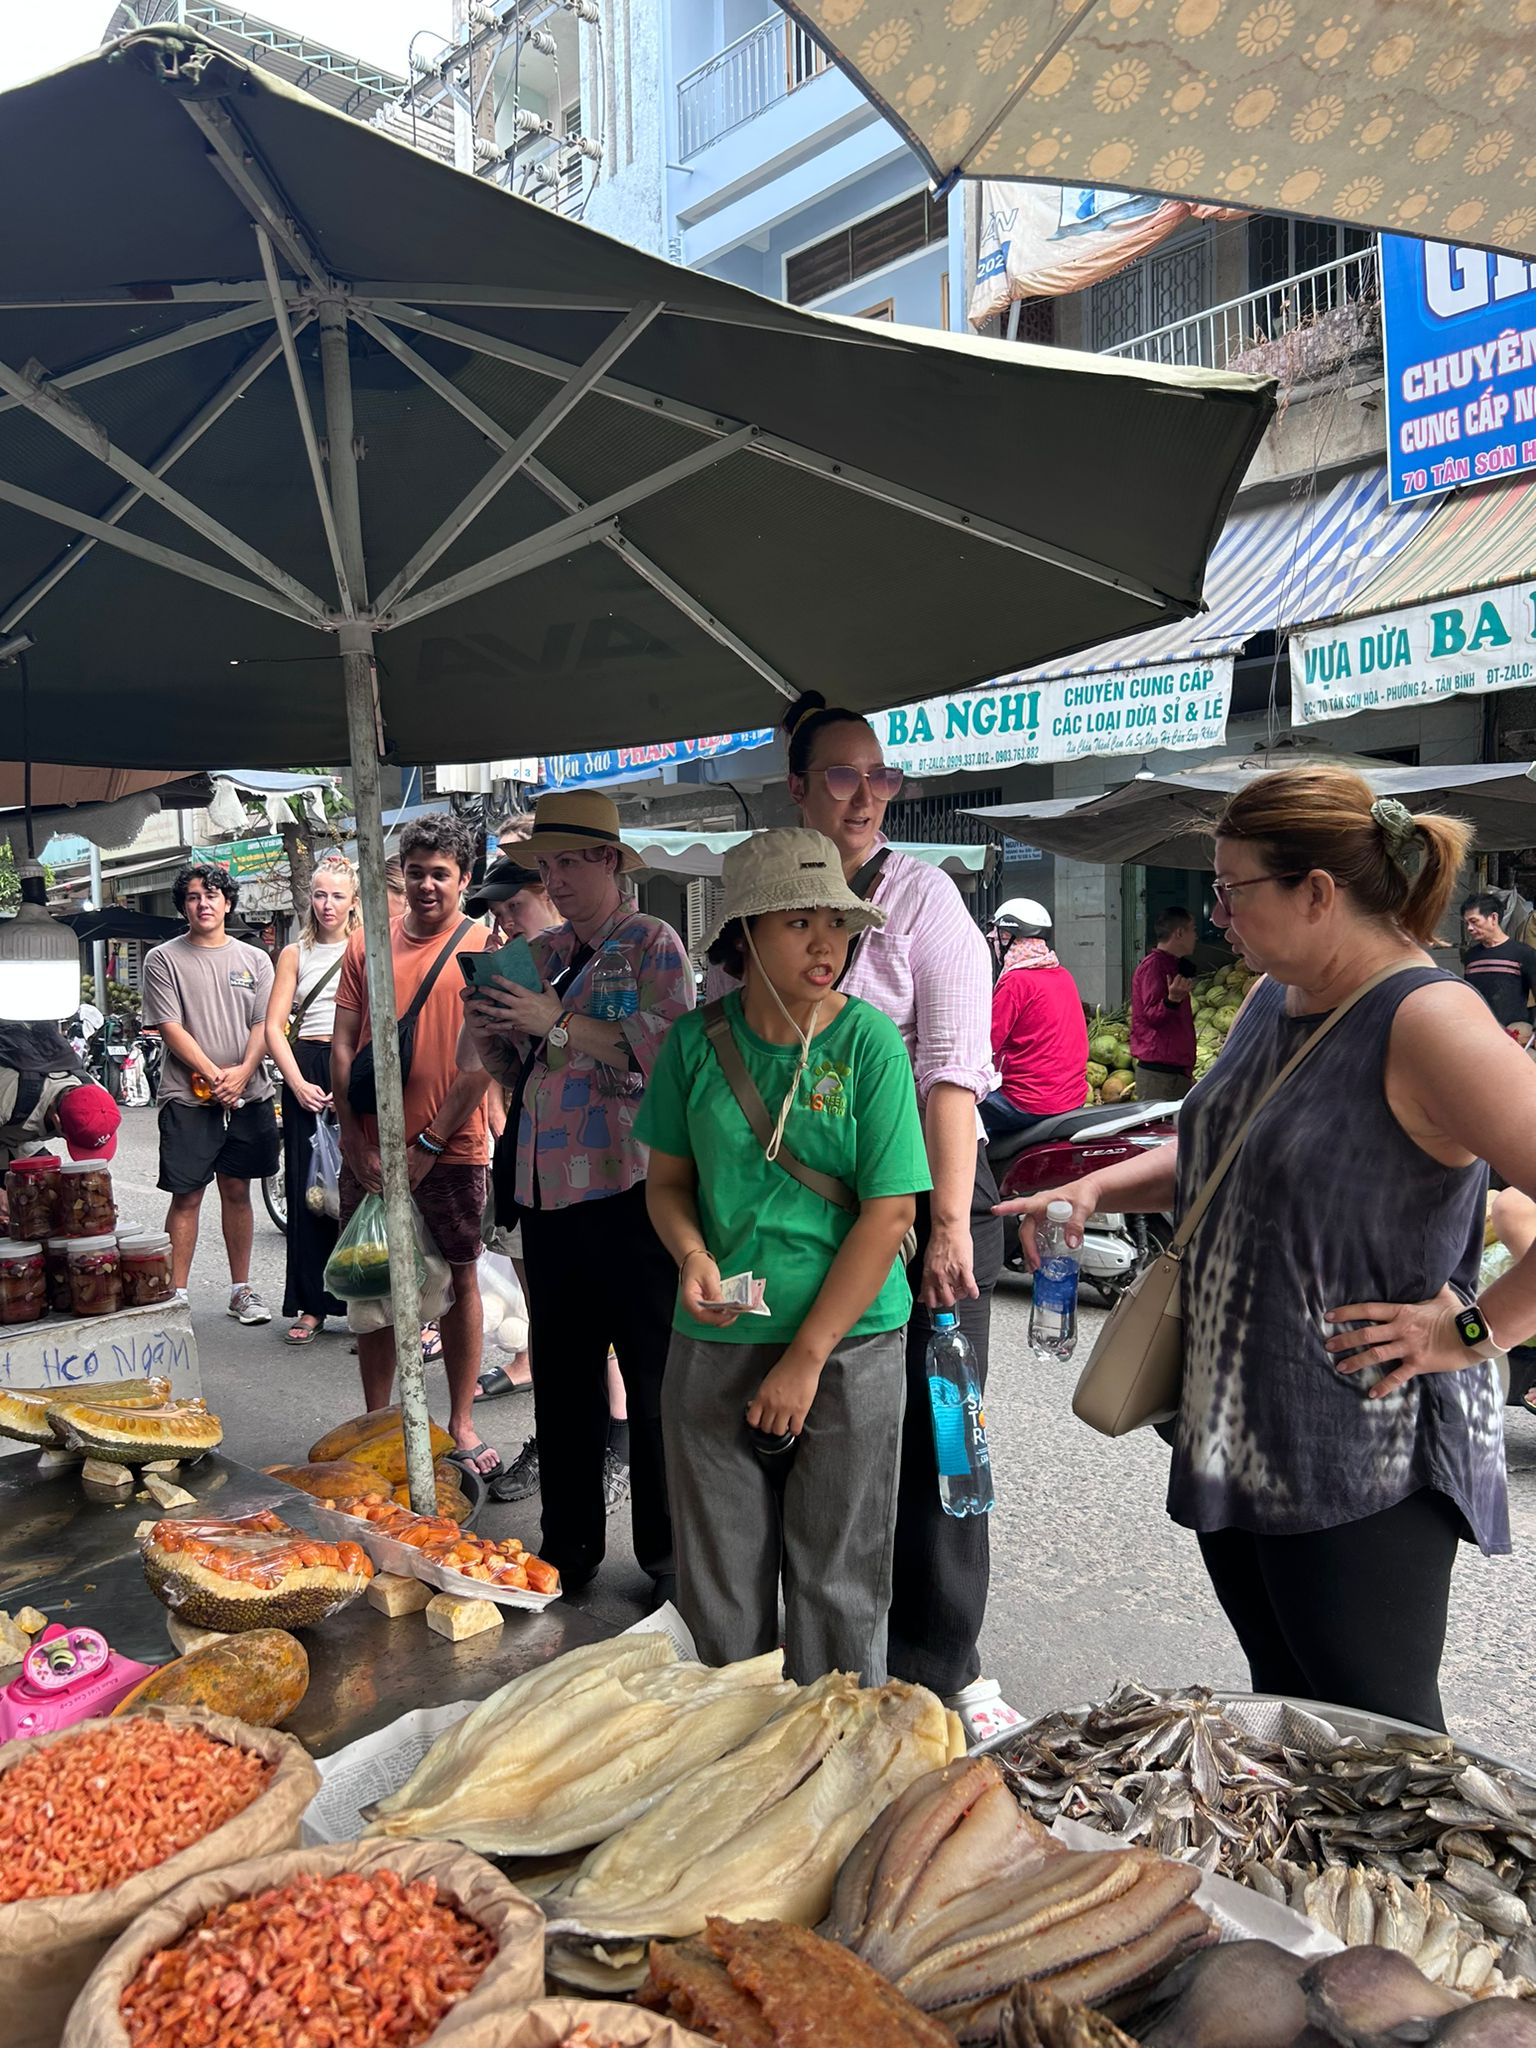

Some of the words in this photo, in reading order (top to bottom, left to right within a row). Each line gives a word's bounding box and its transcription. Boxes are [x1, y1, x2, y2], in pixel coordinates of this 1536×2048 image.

[1400, 407, 1460, 454] CUNG
[1464, 385, 1509, 436] CẤP
[1402, 469, 1427, 493] 70
[1431, 456, 1470, 486] TÂN
[1475, 444, 1516, 475] SƠN
[1304, 640, 1351, 689] VỰA
[1359, 624, 1411, 674] DỪA
[1430, 600, 1512, 658] BA
[1064, 679, 1124, 707] CHUYÊN
[1129, 674, 1174, 699] CUNG
[1421, 681, 1427, 695] 2
[1436, 674, 1452, 692] TÂN
[1455, 671, 1475, 689] BÌNH
[1487, 662, 1533, 684] ĐT-ZALO:
[888, 706, 934, 746] BA
[945, 690, 1041, 741] NGHỊ
[1053, 713, 1082, 736] CÁC
[1087, 711, 1121, 735] LOẠI
[1126, 703, 1156, 728] DỪA
[1162, 696, 1180, 724] SỈ
[1185, 702, 1198, 722] &
[1204, 692, 1223, 720] LẺ
[514, 769, 519, 777] 2
[525, 769, 531, 777] 3
